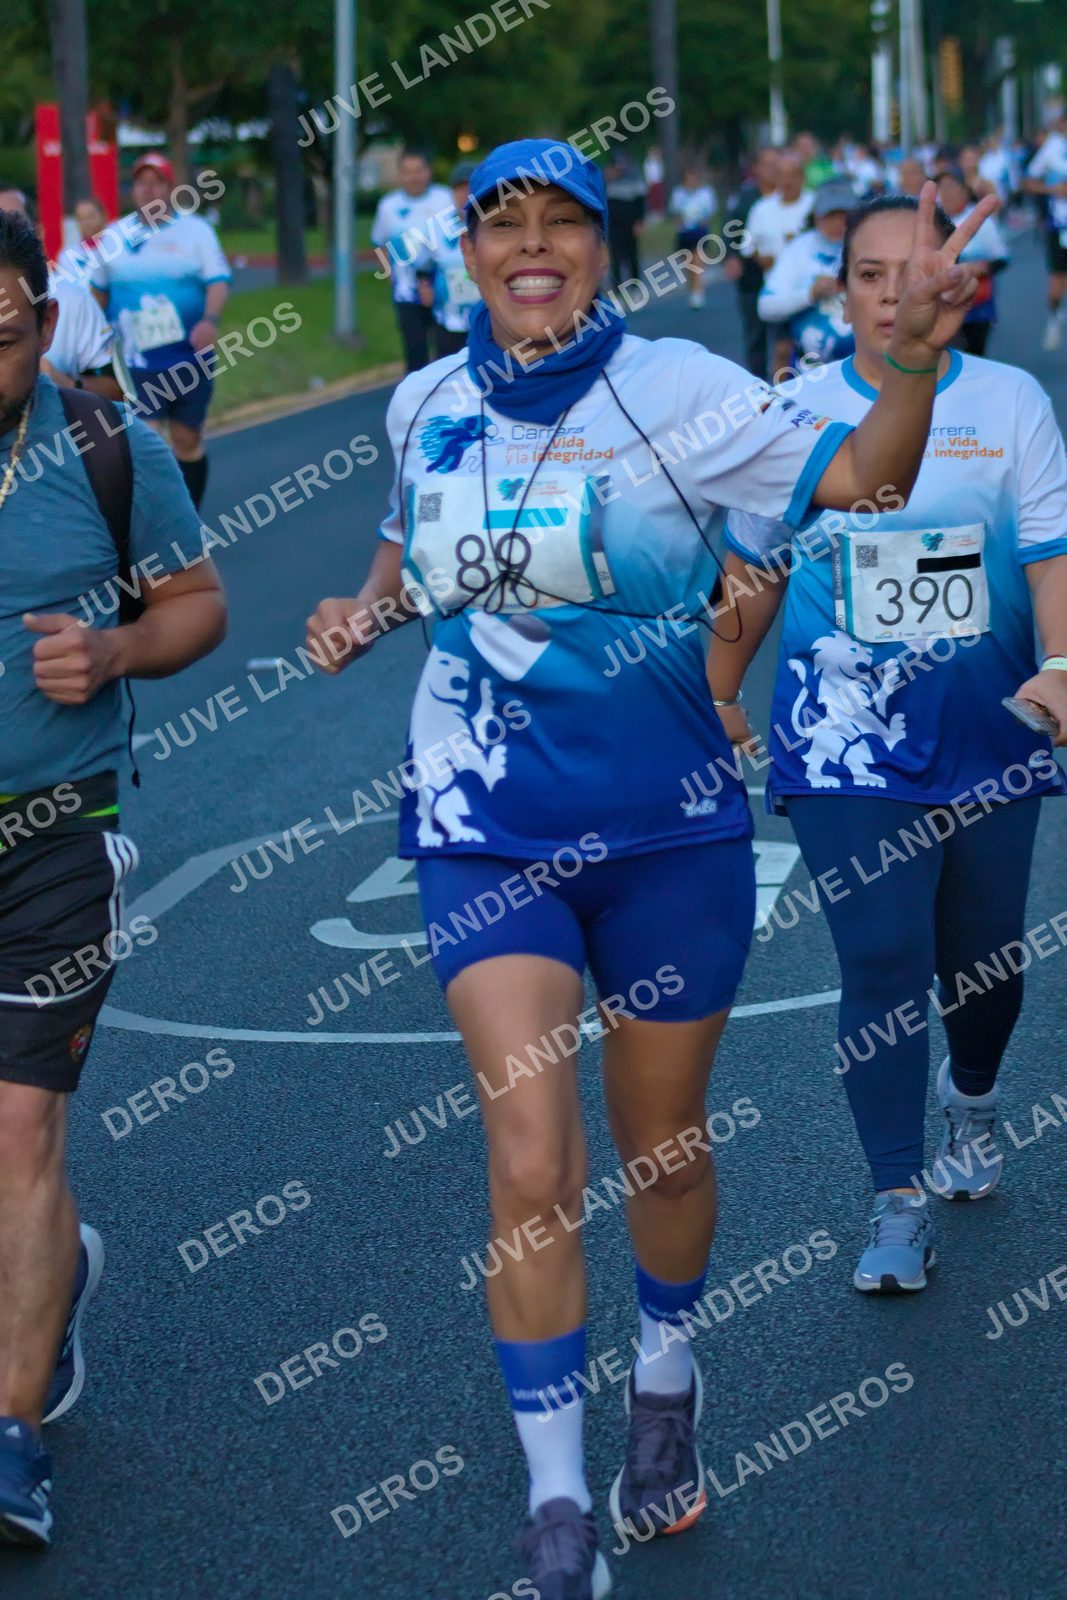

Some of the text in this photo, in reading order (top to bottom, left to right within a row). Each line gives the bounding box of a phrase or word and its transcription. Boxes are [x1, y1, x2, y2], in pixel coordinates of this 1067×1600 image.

[511, 424, 586, 440] Carrera
[928, 426, 976, 437] rrera
[551, 436, 585, 448] Vida
[947, 437, 978, 447] Vida
[934, 447, 1004, 460] Integridad
[455, 531, 532, 594] 89
[875, 574, 973, 626] 390
